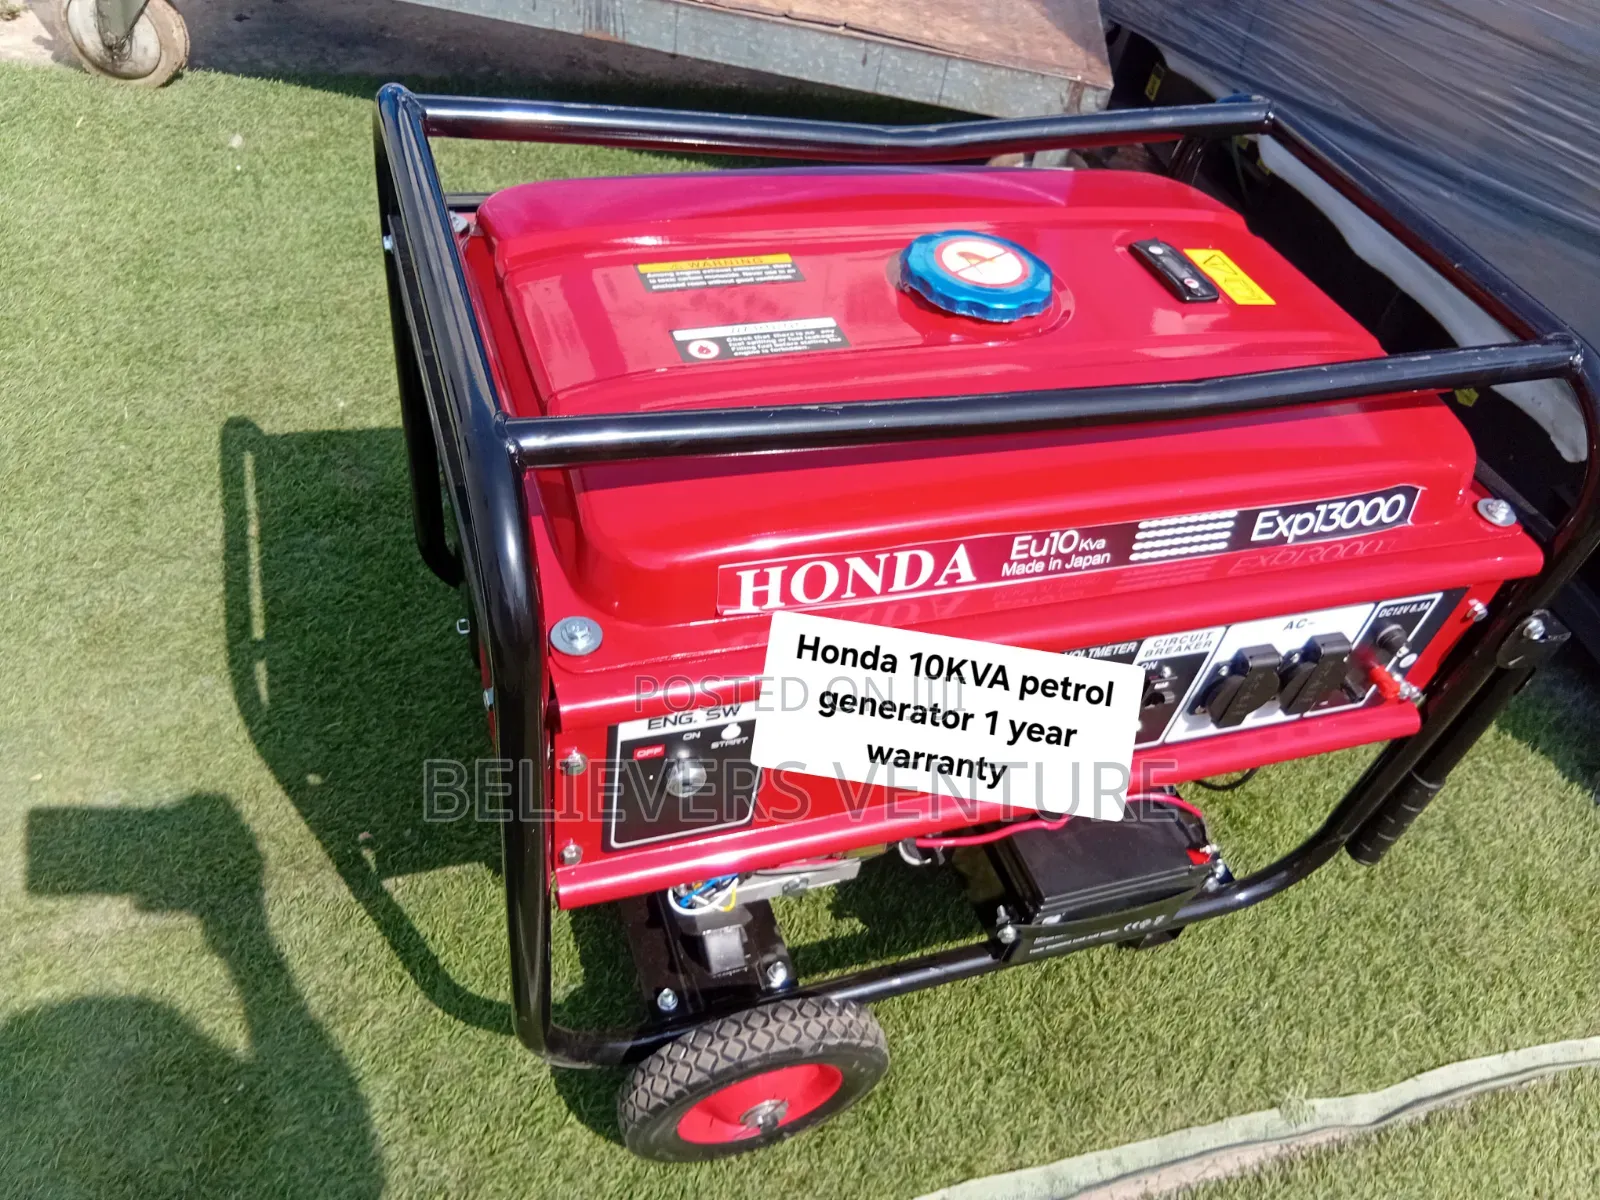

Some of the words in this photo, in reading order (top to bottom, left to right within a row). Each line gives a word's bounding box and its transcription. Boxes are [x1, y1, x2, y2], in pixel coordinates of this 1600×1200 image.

[688, 258, 763, 268] WARNING
[1251, 493, 1407, 544] Exp13000
[1010, 529, 1080, 561] Eu10
[1079, 537, 1107, 552] Kva
[1001, 558, 1046, 577] Made
[1048, 556, 1063, 572] in
[1064, 552, 1112, 570] Japan
[722, 543, 978, 615] HONDA
[1144, 639, 1214, 659] BREAKER
[1153, 630, 1215, 649] CIRCUIT
[1064, 640, 1138, 659] OLTMETER
[648, 711, 698, 731] ENG.
[706, 704, 742, 721] SW
[682, 730, 701, 741] ON
[710, 736, 749, 750] START
[636, 745, 663, 758] OFF
